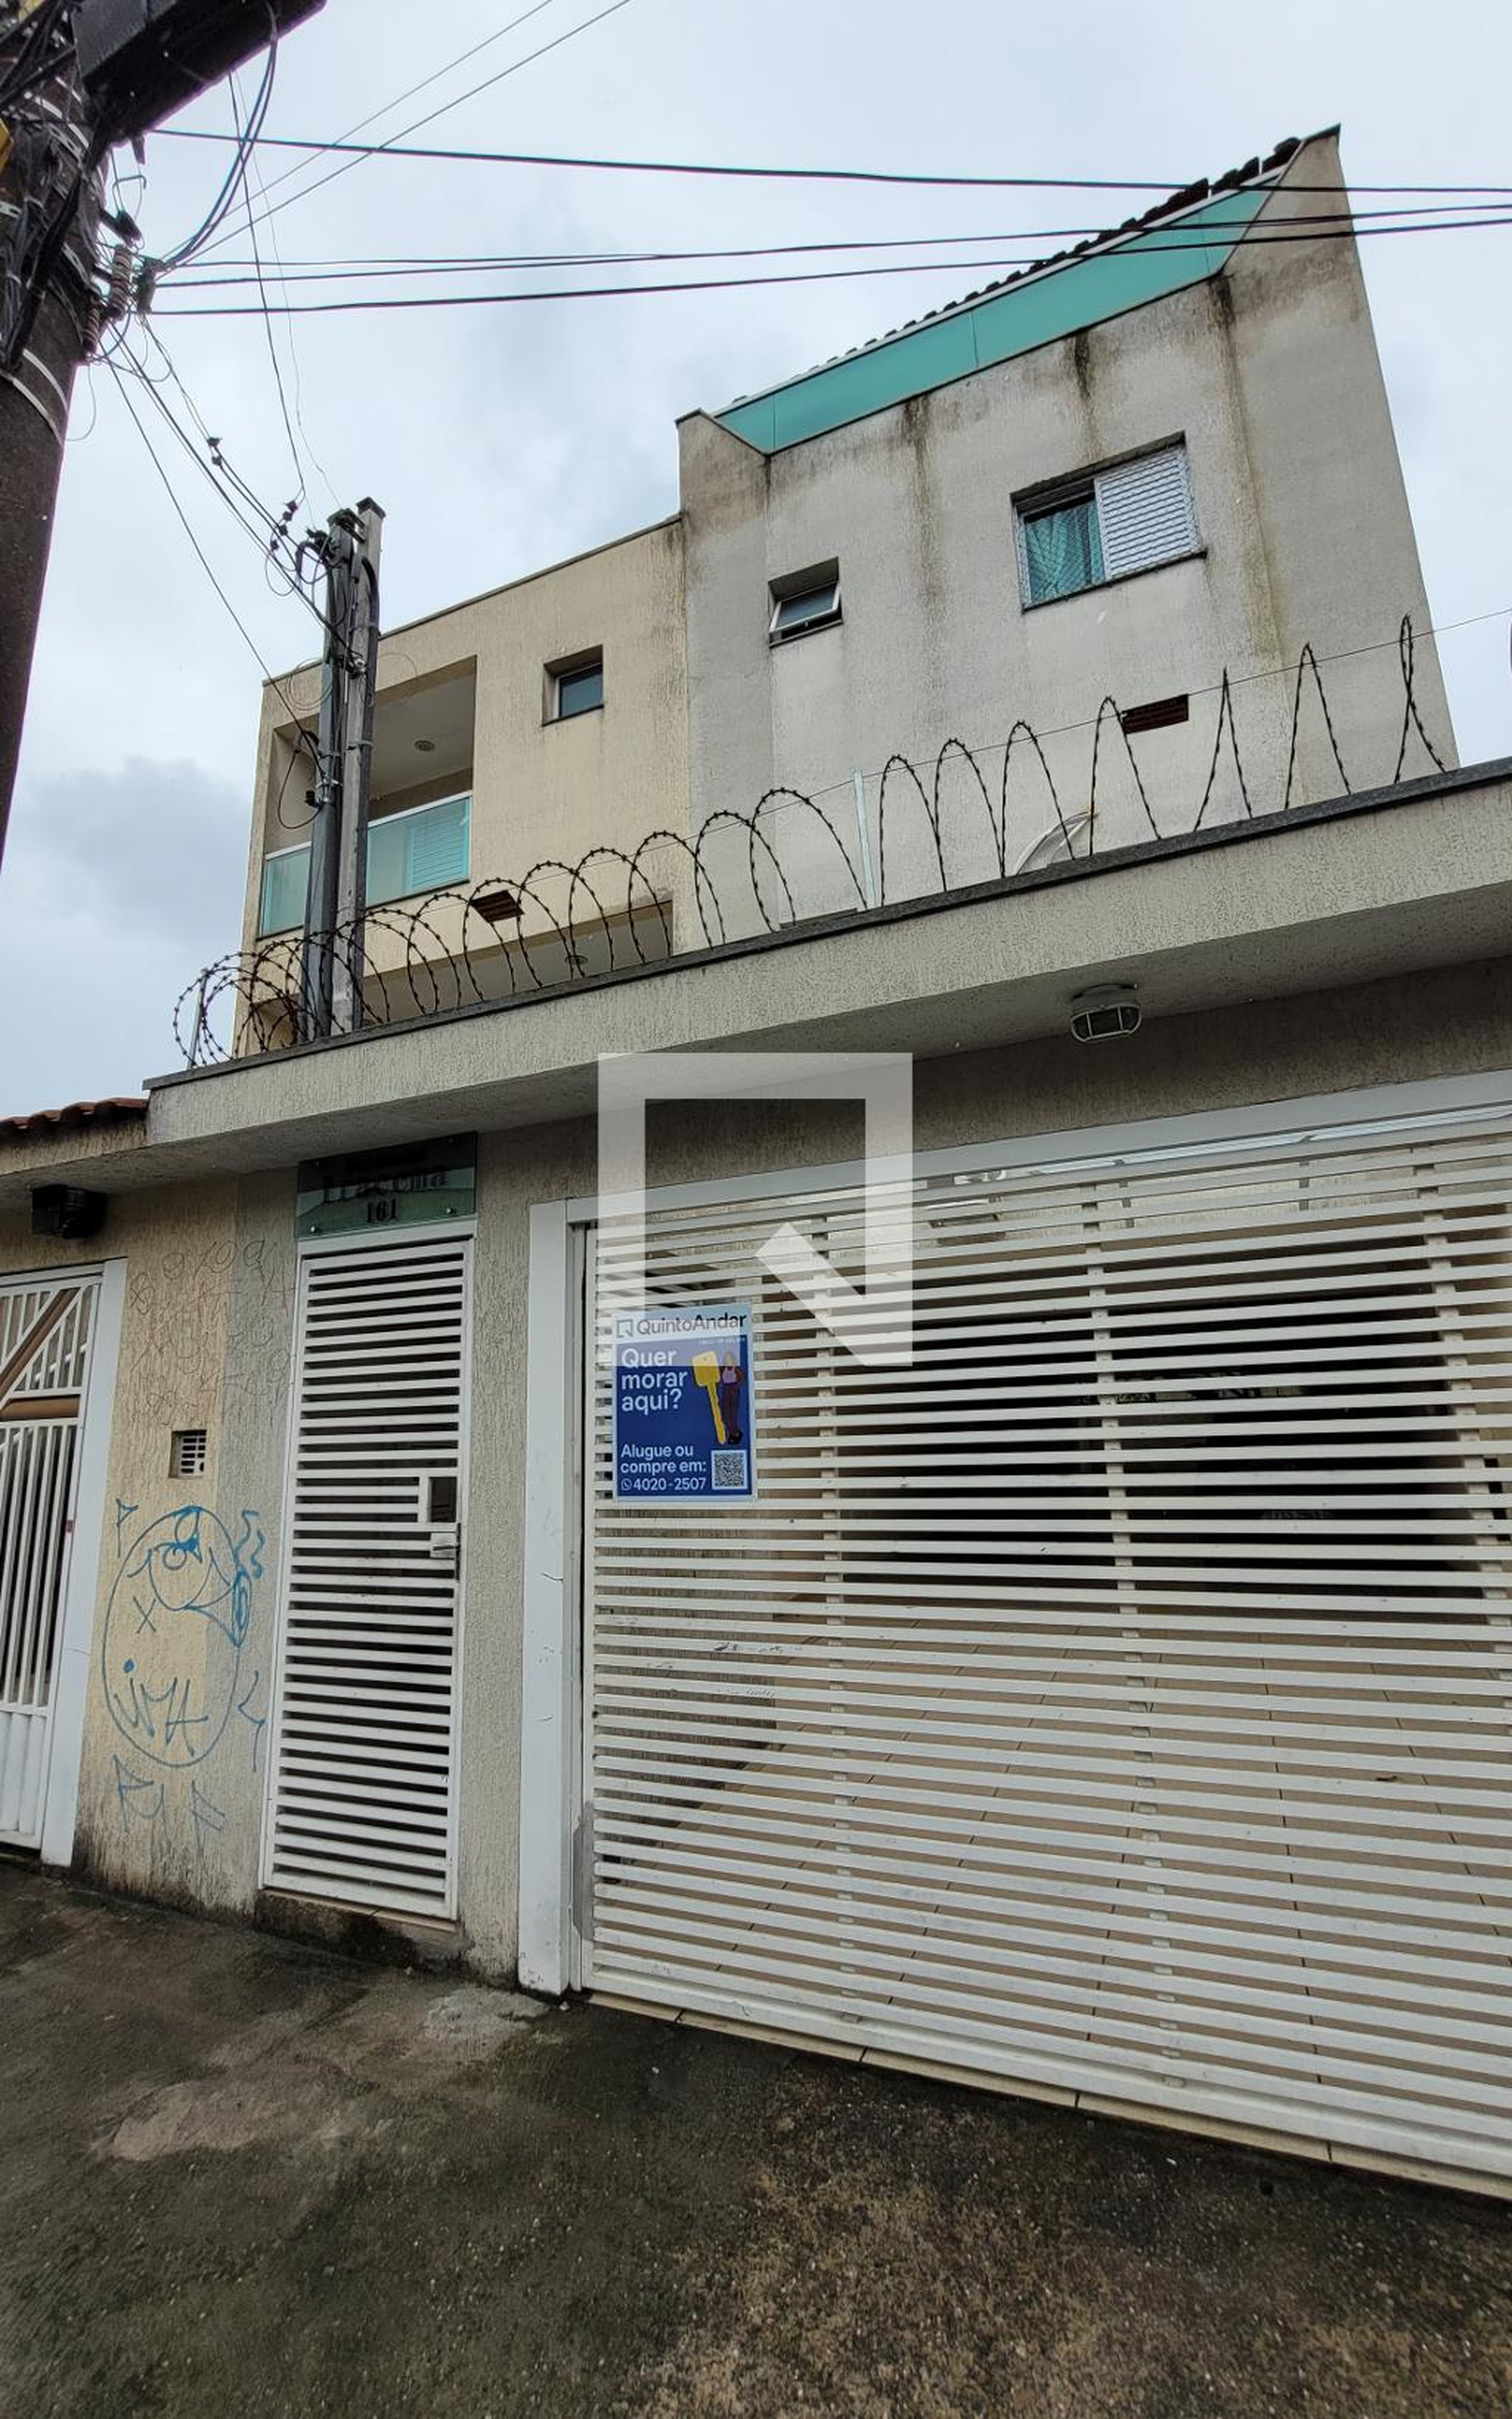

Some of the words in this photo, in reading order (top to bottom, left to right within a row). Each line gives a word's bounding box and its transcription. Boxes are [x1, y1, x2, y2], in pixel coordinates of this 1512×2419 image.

[637, 1312, 747, 1335] QuintoAndar
[622, 1348, 677, 1369] Quer
[622, 1371, 688, 1390] morar
[621, 1388, 682, 1415] aqui?
[621, 1444, 672, 1461] Alugue
[674, 1445, 693, 1457] ou
[621, 1461, 676, 1475] compre
[679, 1461, 706, 1472] em:
